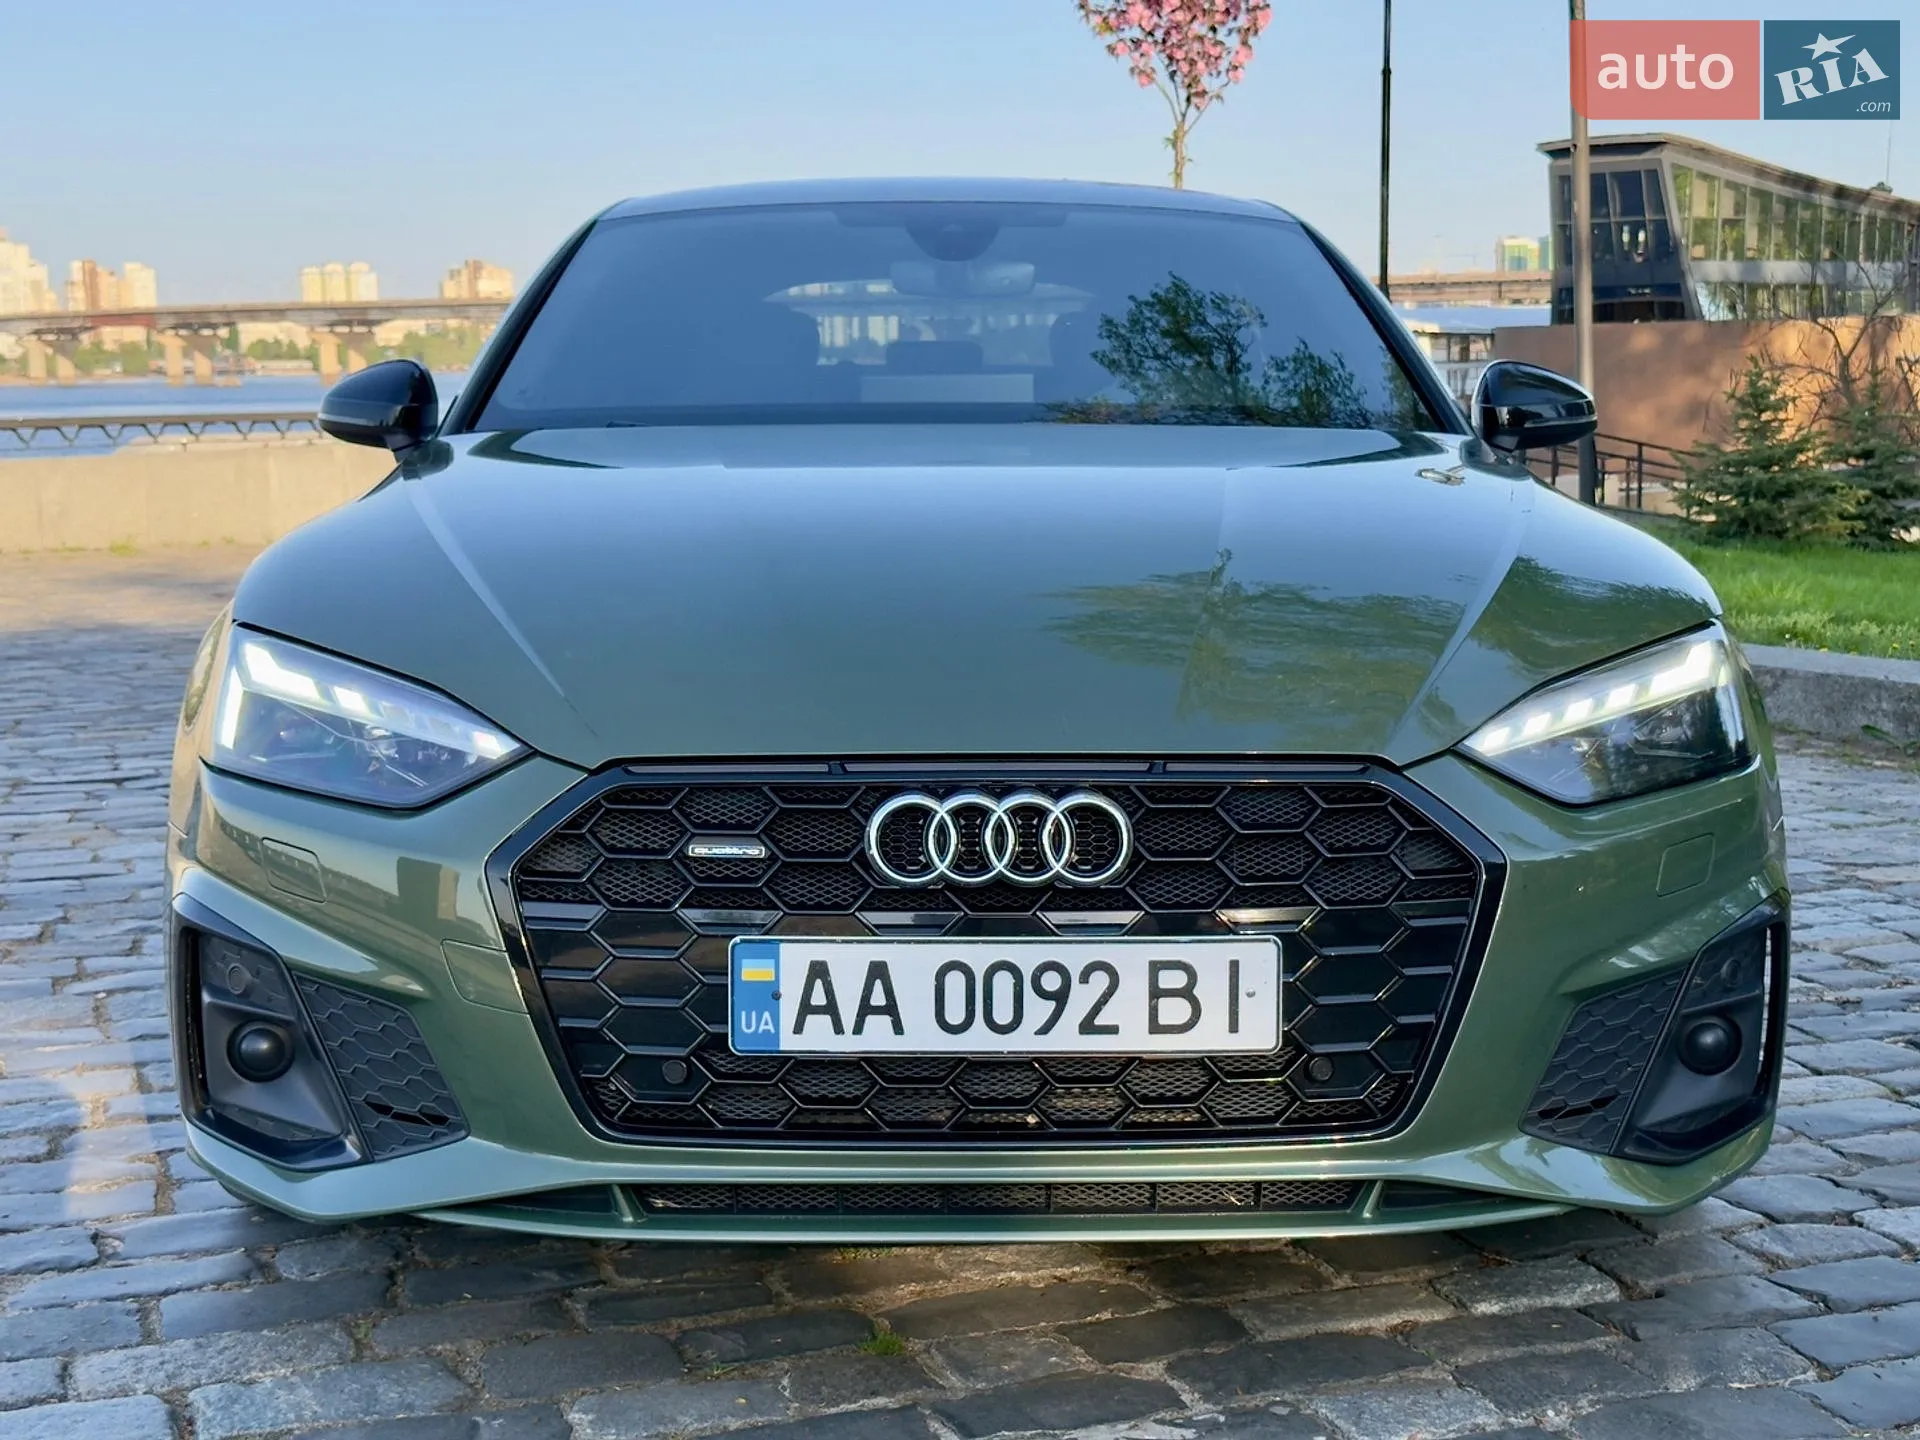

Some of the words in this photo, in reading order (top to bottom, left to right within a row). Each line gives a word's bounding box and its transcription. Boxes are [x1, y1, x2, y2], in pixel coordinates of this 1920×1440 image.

[741, 1011, 776, 1034] UA
[792, 960, 905, 1036] AA
[934, 959, 1120, 1036] 0092
